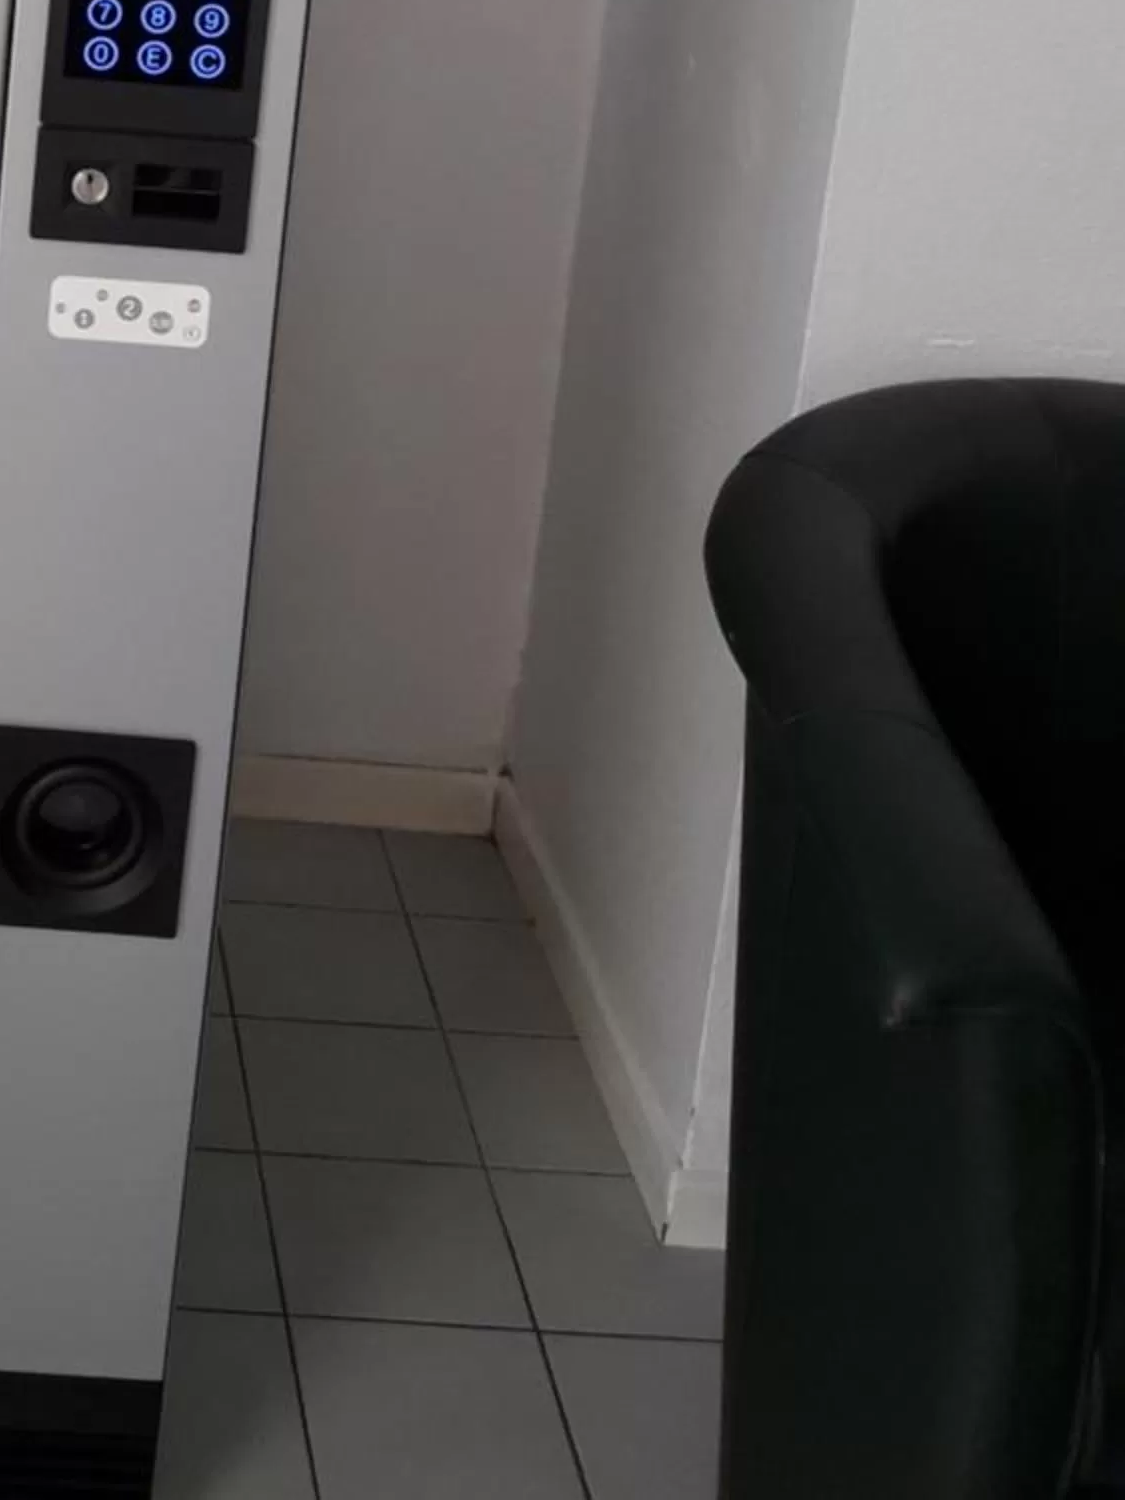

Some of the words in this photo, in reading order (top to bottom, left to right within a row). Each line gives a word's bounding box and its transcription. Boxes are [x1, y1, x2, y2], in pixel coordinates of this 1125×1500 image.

[98, 3, 113, 22] 7
[150, 7, 166, 27] 8
[204, 11, 220, 31] 9
[93, 43, 109, 63] 0
[146, 48, 161, 68] E
[198, 51, 217, 72] C
